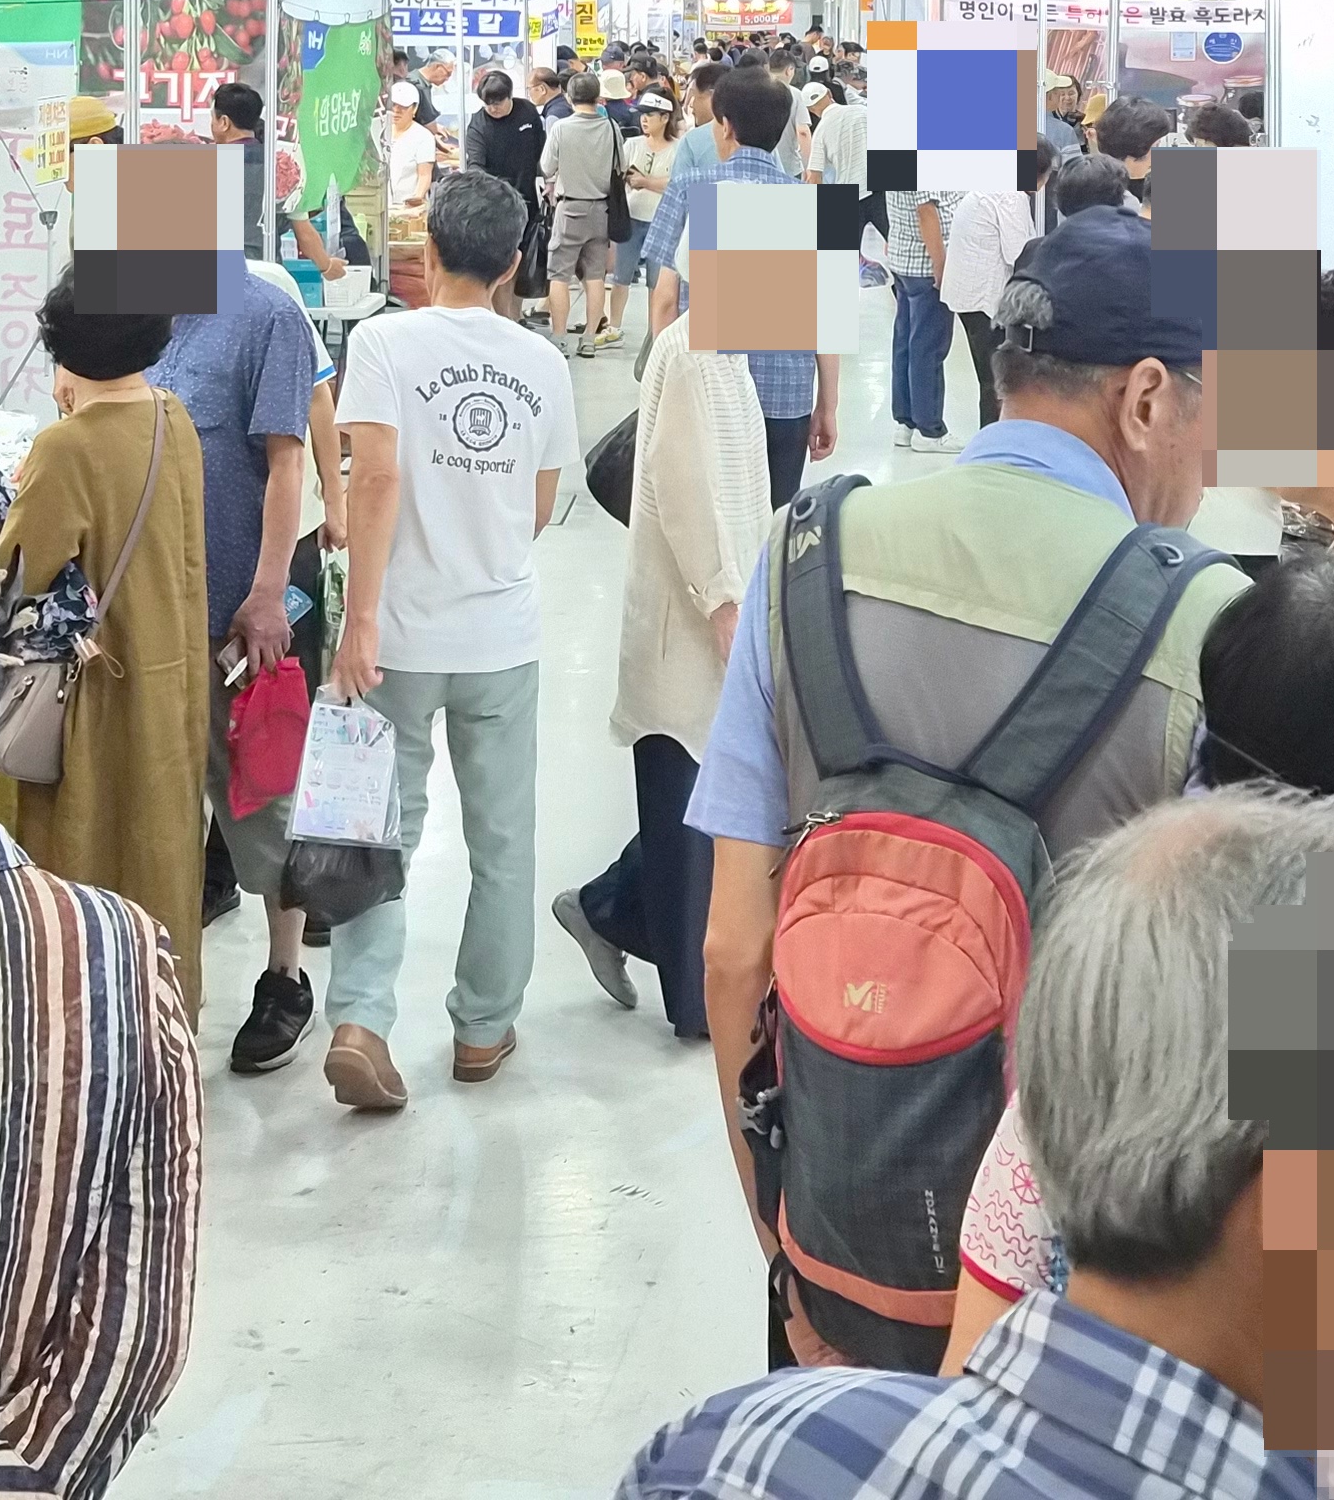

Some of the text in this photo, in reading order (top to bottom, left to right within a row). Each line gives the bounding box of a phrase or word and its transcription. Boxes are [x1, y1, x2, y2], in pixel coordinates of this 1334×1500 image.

[959, 1, 1014, 20] 명인이
[1150, 6, 1187, 25] 발효
[415, 364, 542, 417] Le Club Français
[431, 449, 517, 475] le coq sportif
